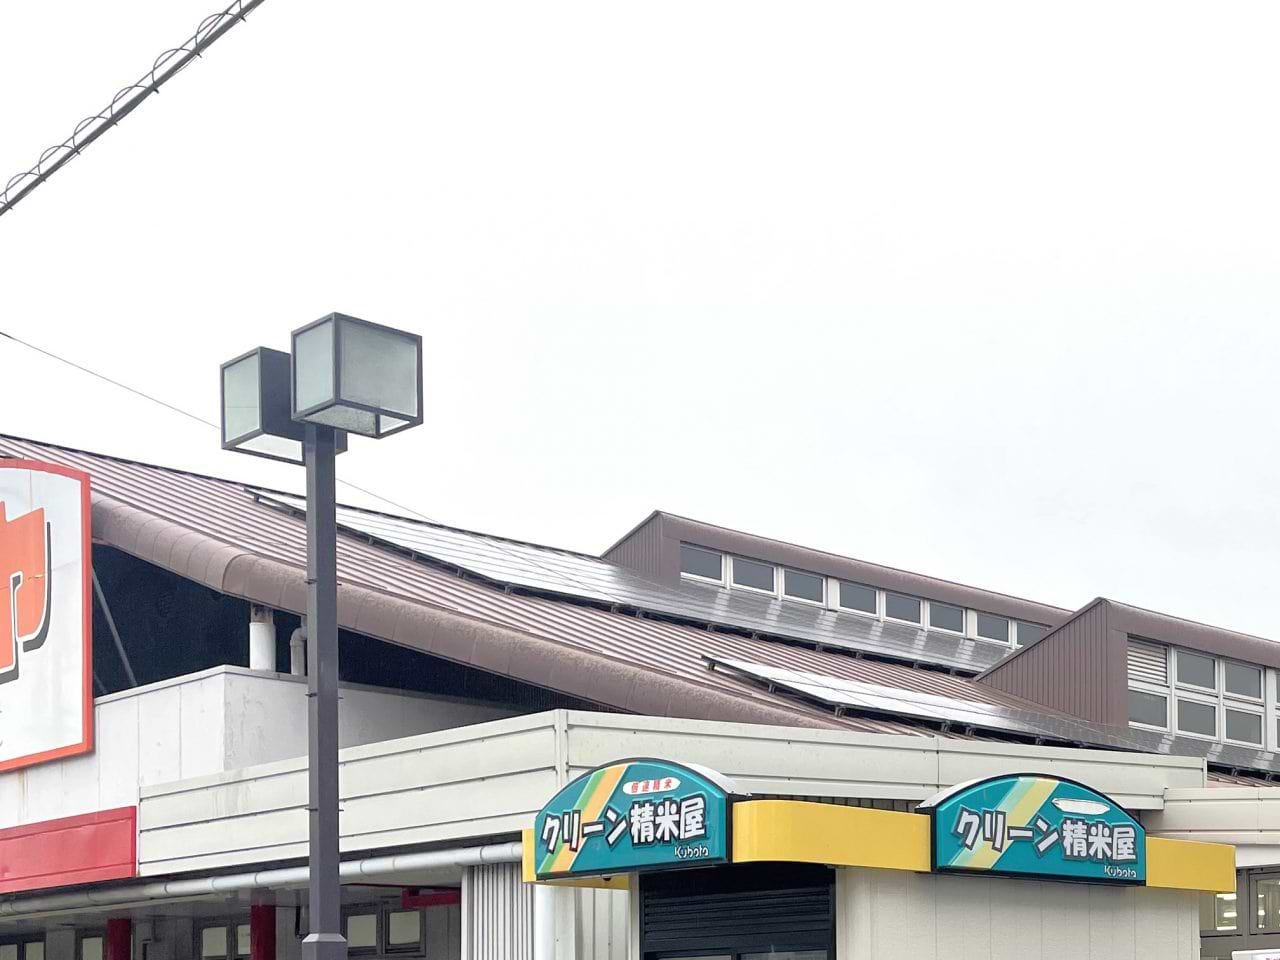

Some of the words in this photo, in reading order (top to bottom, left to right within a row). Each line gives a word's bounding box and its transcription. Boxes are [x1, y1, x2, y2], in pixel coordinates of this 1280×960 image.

[542, 796, 707, 853] クリーン精米屋
[956, 809, 1138, 861] クリーン精米屋
[674, 845, 709, 859] Kubota
[1104, 865, 1137, 878] Kubota
